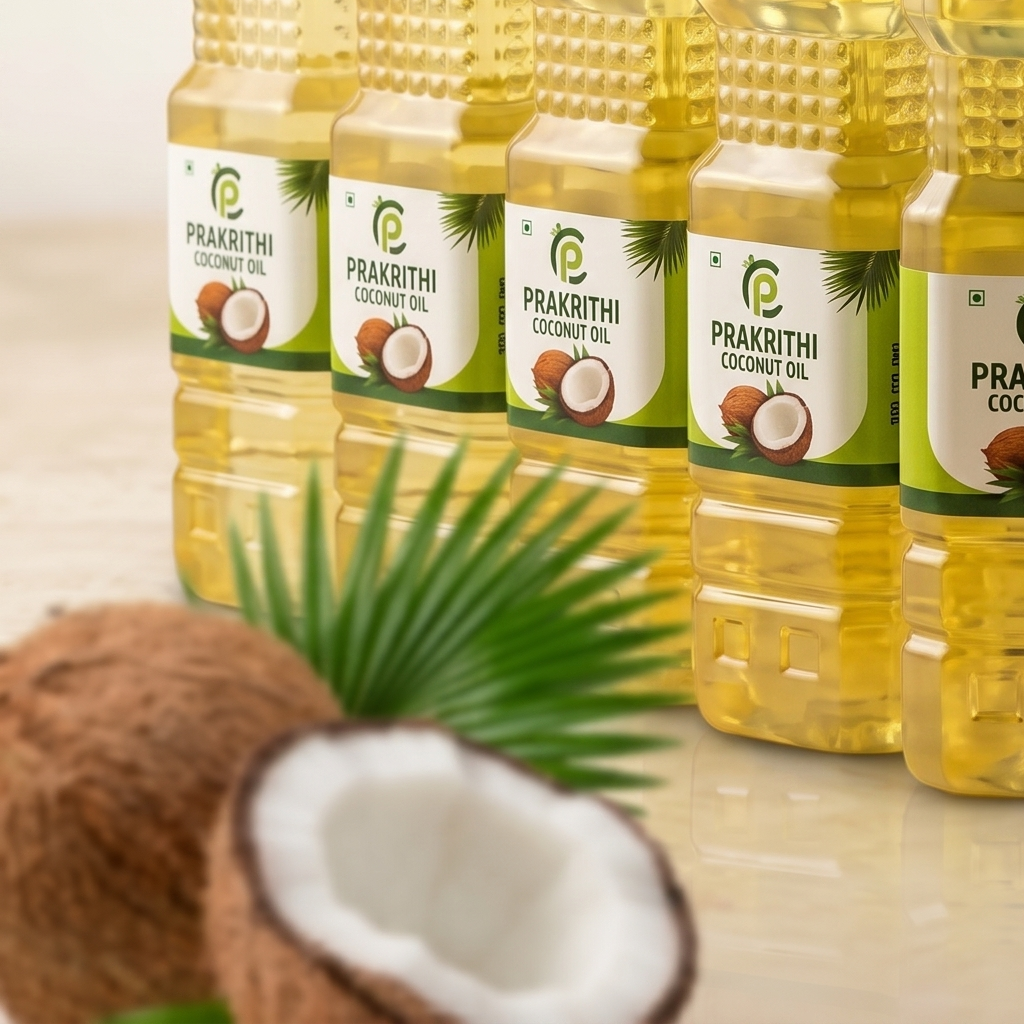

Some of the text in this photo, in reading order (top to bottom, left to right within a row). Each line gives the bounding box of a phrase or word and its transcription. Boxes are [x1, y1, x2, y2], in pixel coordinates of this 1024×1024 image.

[186, 222, 273, 257] PRAKRITHI
[194, 251, 267, 276] COCONUT OIL
[347, 257, 436, 294] PRAKRITHI
[354, 286, 429, 313] COCONUT OIL
[524, 286, 620, 325] PRAKRITHI
[532, 318, 611, 345] COCONUT OIL
[711, 320, 818, 360] PRAKRITHI
[721, 352, 809, 381] COCONUT OIL
